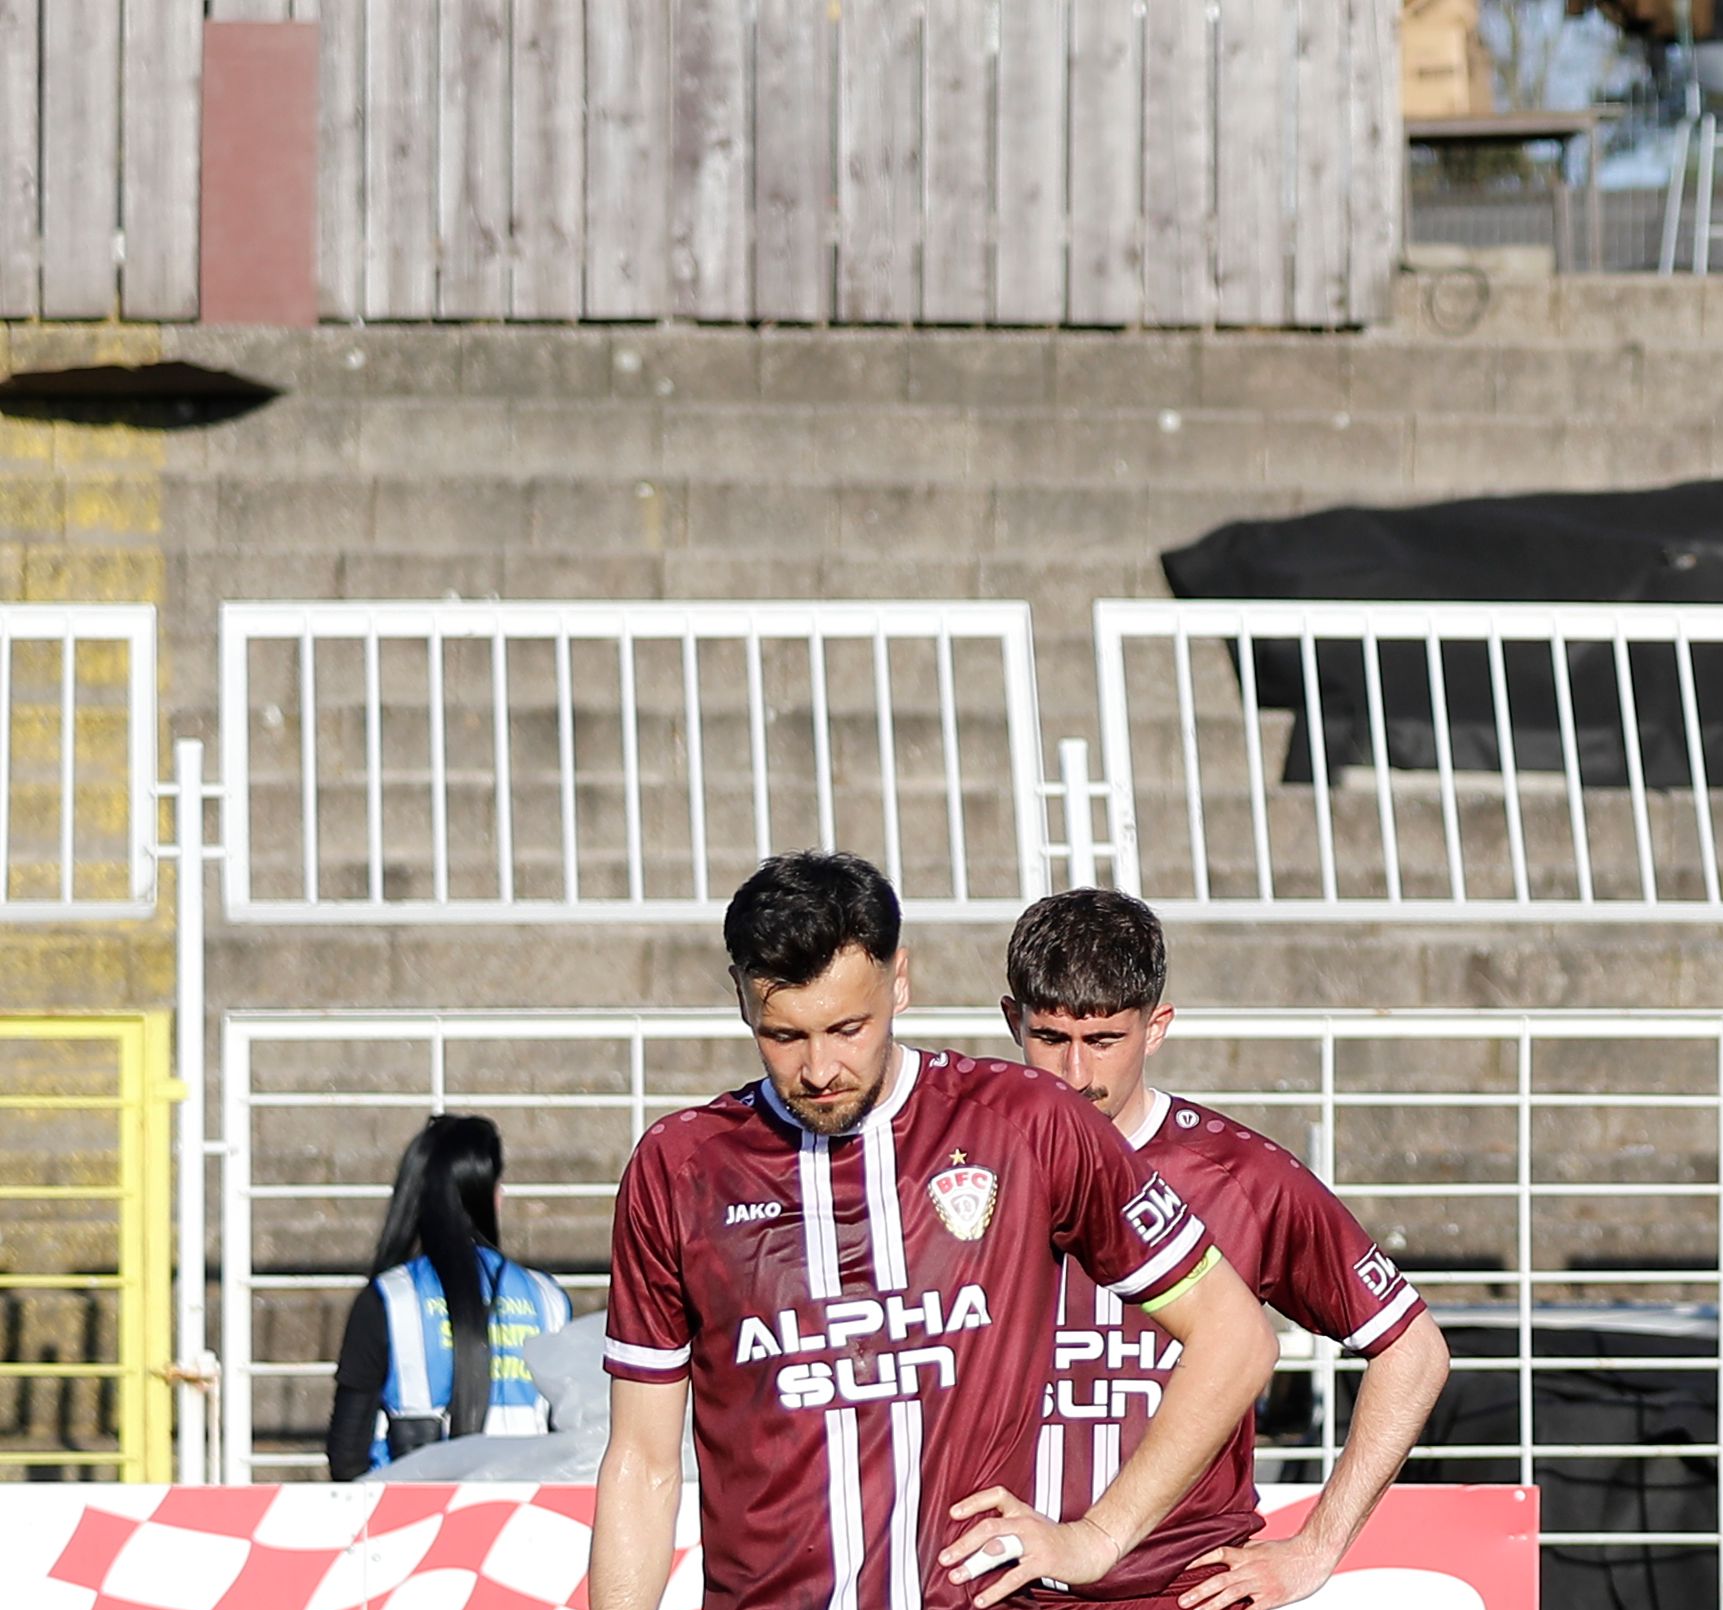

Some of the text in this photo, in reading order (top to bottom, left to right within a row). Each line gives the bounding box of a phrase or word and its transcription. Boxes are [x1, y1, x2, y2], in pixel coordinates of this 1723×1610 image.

[935, 1170, 988, 1195] BFC
[725, 1202, 782, 1225] JAKO
[1125, 1178, 1184, 1244] DW
[735, 1284, 993, 1365] ALPHA
